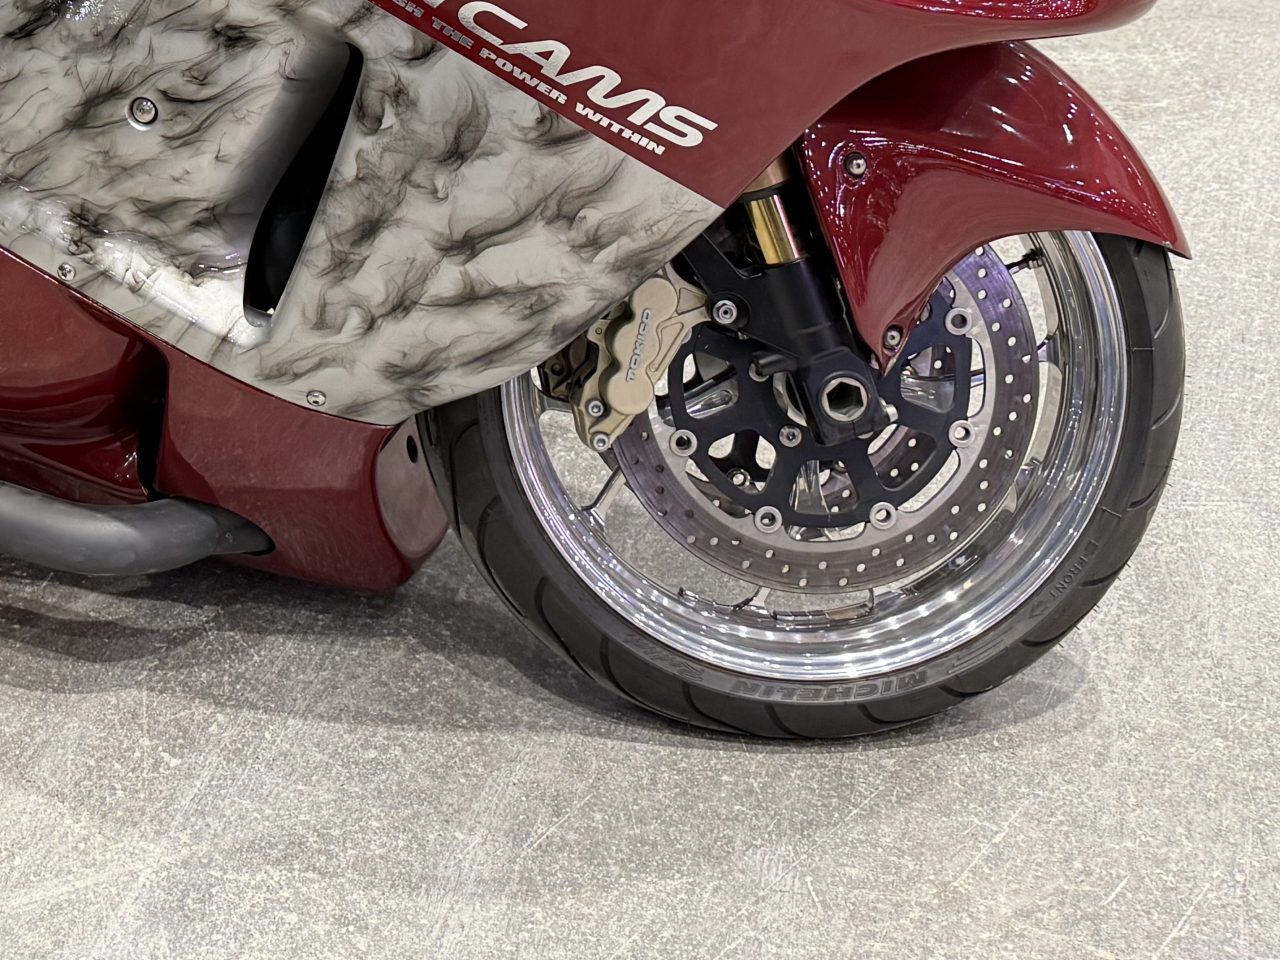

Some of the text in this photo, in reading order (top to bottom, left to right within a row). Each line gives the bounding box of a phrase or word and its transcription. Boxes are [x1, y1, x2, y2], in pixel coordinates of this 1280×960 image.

[431, 15, 473, 48] THE
[479, 47, 567, 105] POWER
[575, 102, 666, 156] WITHIN
[625, 309, 652, 382] TOKICO
[1048, 554, 1089, 600] FRONT
[730, 668, 929, 702] MICHELIN
